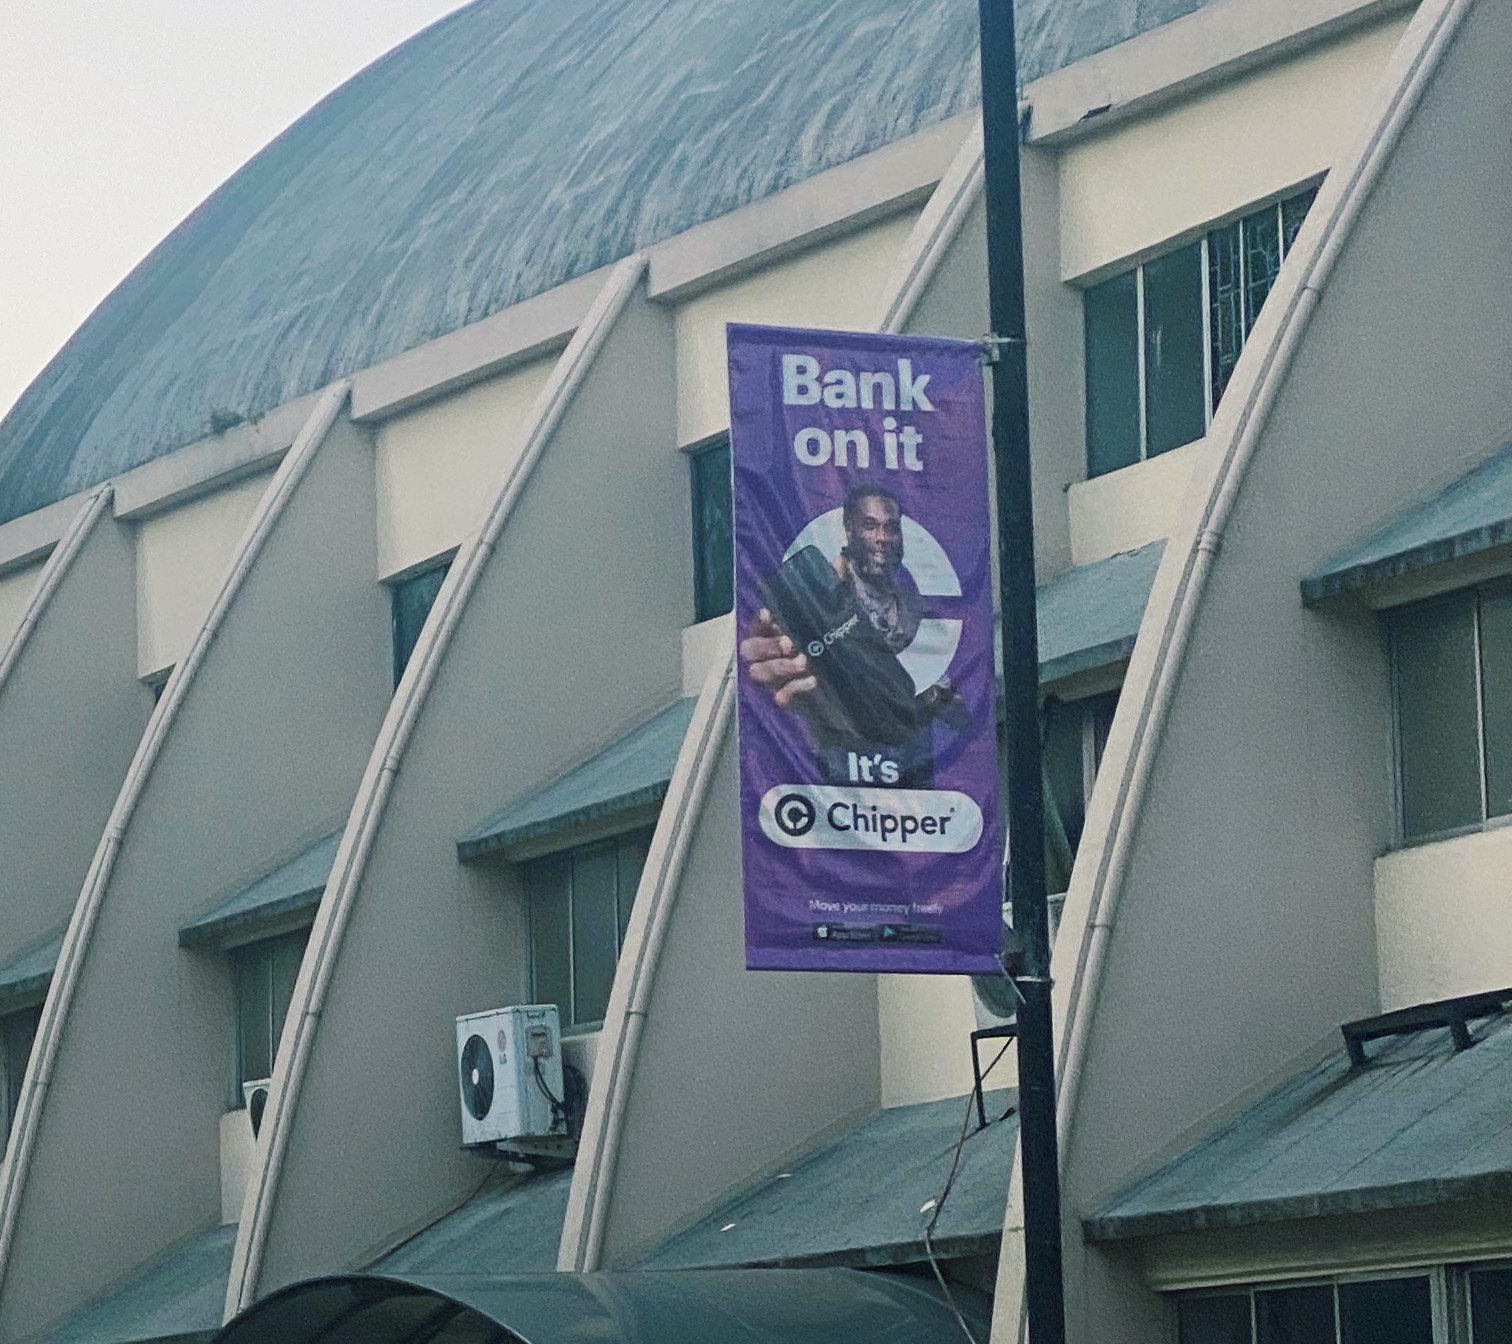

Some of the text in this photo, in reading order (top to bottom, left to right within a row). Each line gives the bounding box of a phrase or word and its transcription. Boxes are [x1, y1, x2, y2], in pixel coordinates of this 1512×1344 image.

[781, 353, 937, 412] Bank
[793, 416, 924, 472] on it
[848, 752, 900, 784] It's
[826, 801, 953, 843] Chipper
[809, 899, 840, 912] Move
